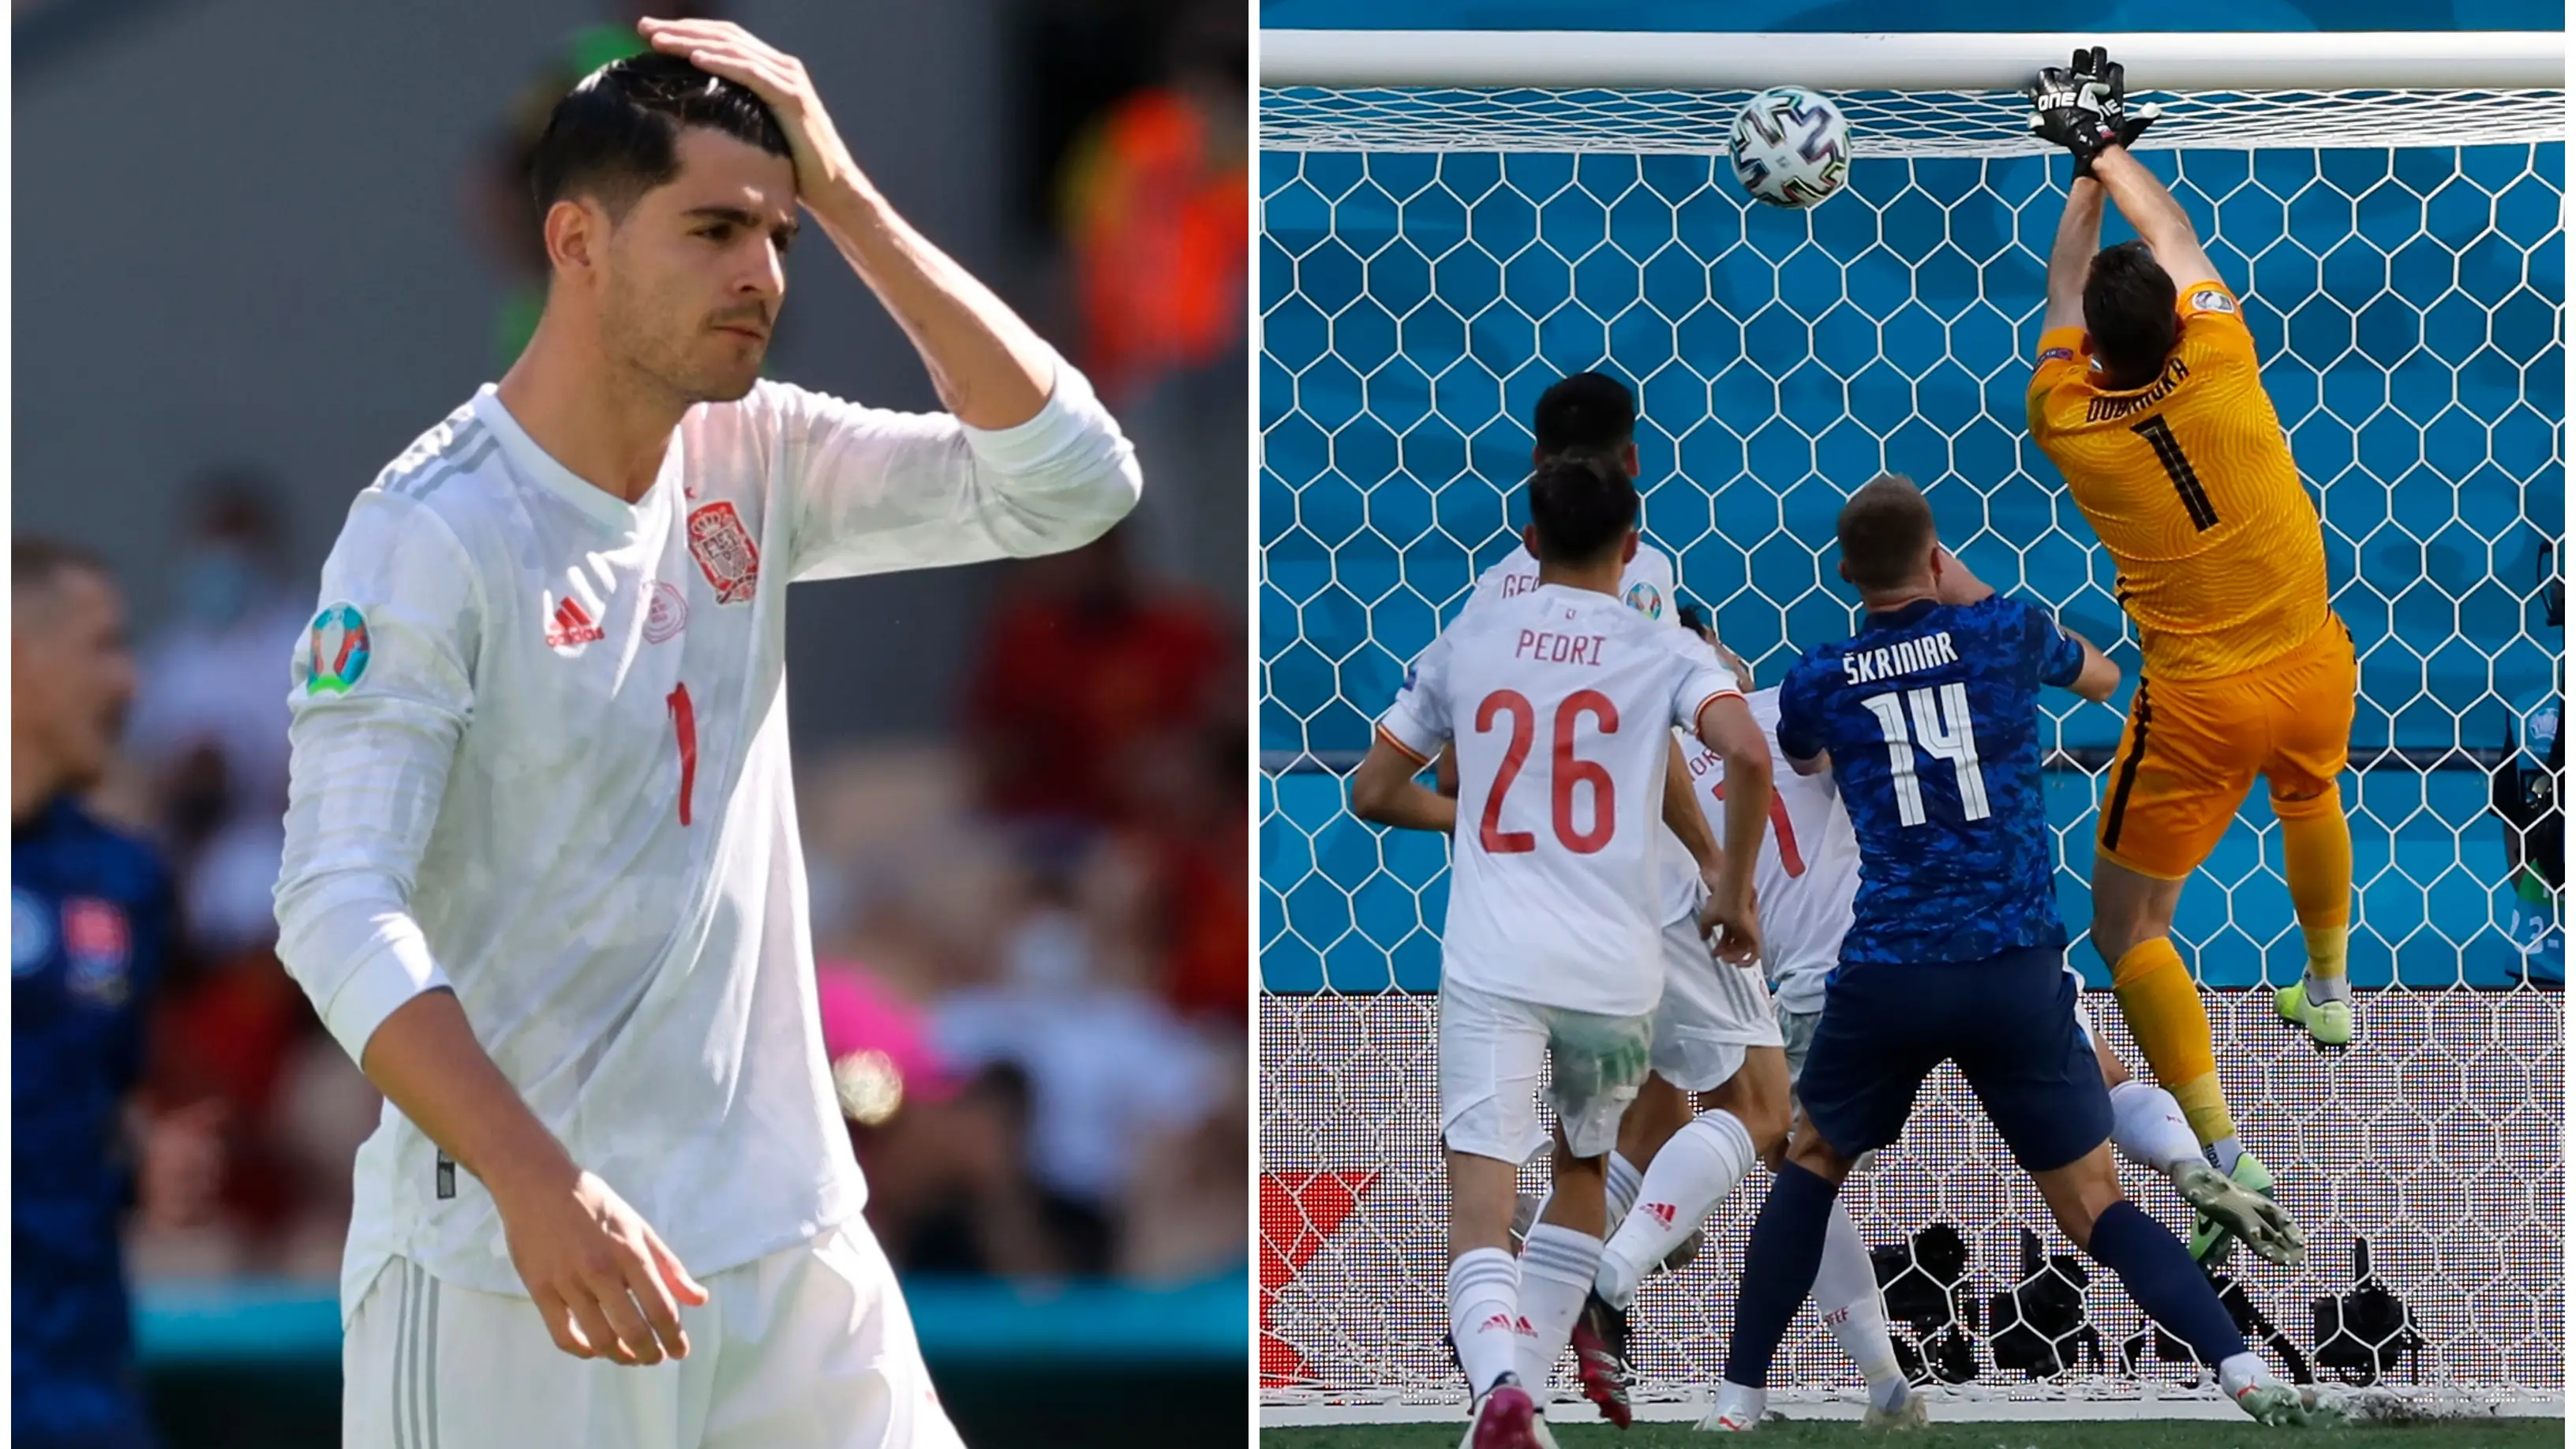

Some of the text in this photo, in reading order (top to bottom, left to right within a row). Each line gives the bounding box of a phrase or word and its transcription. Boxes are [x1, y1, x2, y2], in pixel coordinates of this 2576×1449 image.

[2129, 413, 2220, 534] 1
[1515, 628, 1607, 666] PEDRI
[1843, 631, 1958, 685] ŠKRINIAR
[1475, 689, 1619, 854] 26
[1860, 682, 1991, 827] 14
